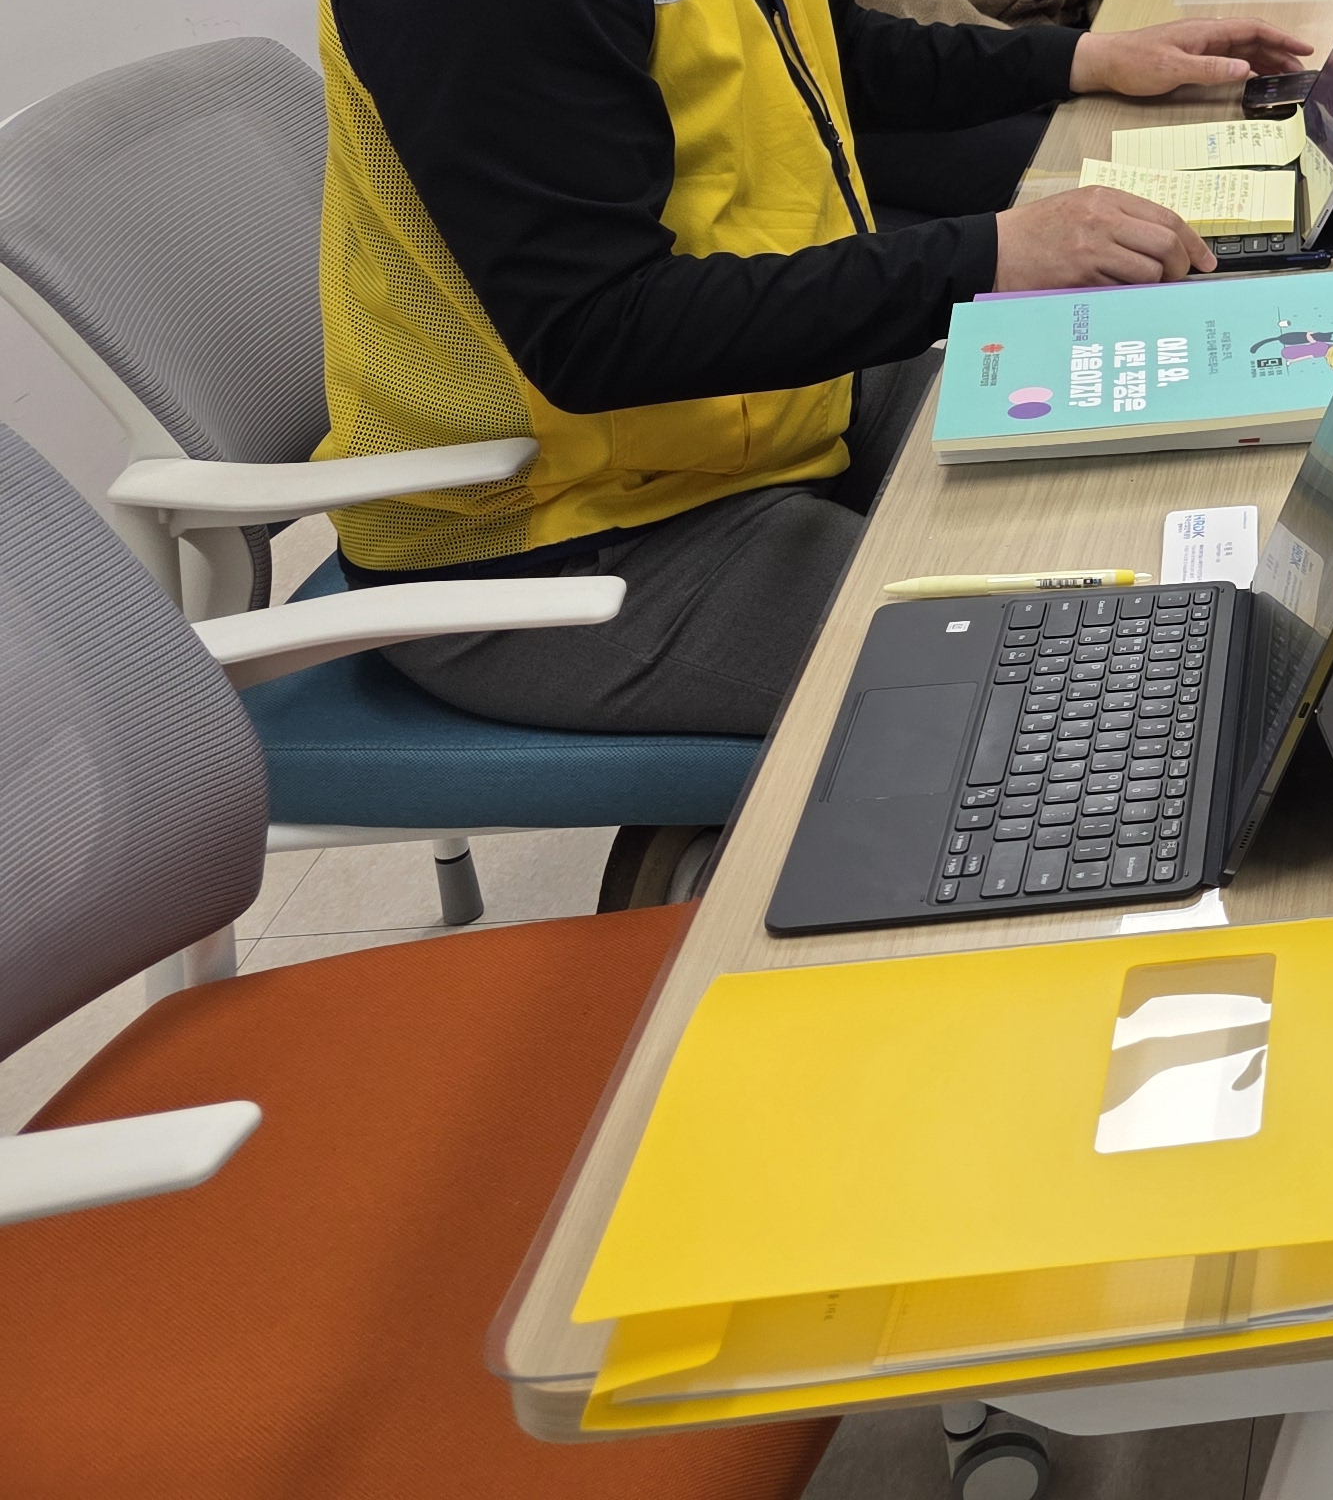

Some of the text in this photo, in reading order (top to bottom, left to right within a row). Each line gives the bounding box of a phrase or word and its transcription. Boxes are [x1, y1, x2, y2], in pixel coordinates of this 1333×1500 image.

[1069, 343, 1103, 408] 처음이지?
[1113, 340, 1147, 412] 이런 직장은
[1157, 337, 1188, 364] 어서
